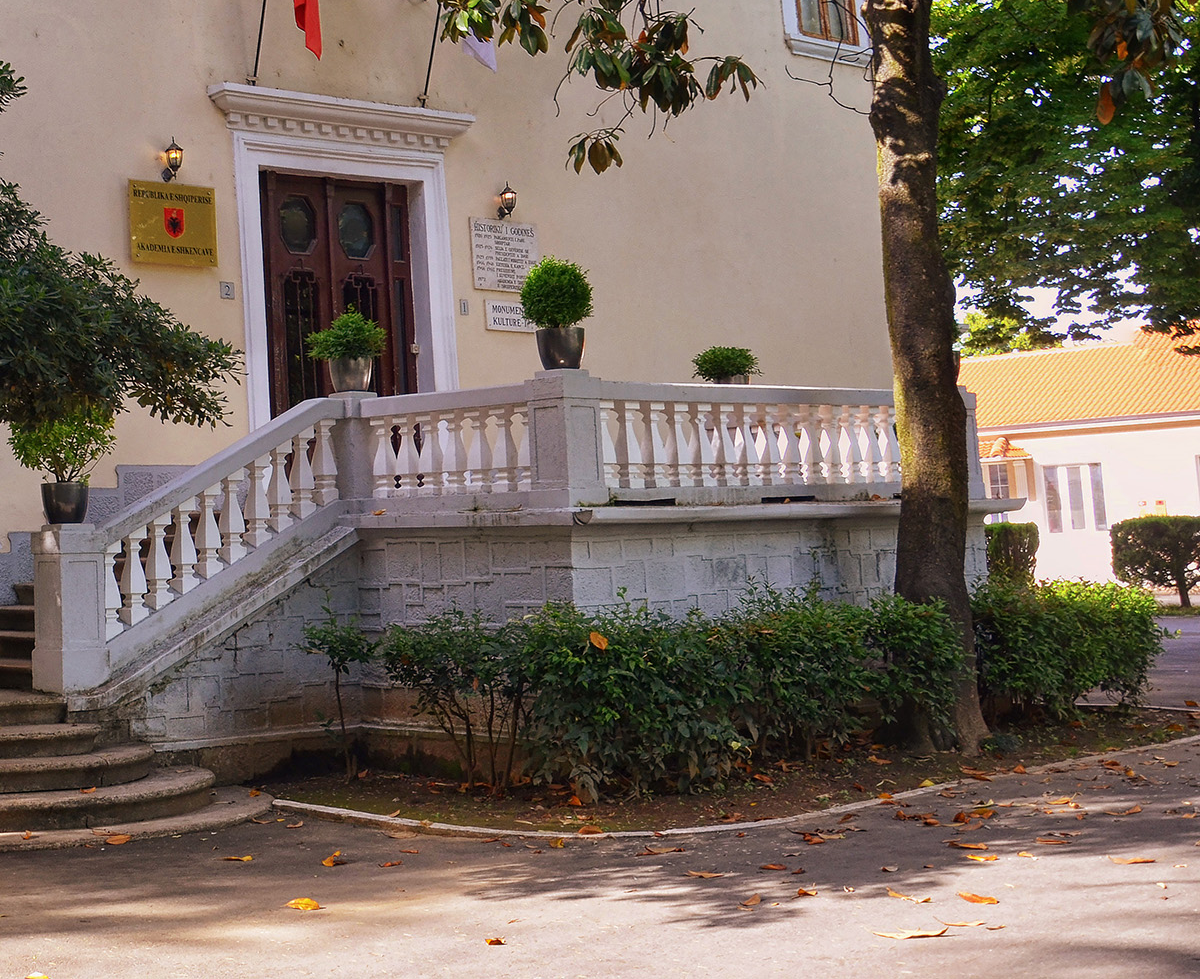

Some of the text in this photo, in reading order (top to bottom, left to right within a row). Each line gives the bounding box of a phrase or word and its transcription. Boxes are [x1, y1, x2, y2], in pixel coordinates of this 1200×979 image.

[133, 189, 169, 201] REPUBLIKA
[137, 242, 171, 253] AKADEMIA
[176, 246, 214, 256] SHKENCAVE
[224, 285, 230, 296] 2
[492, 305, 524, 315] MONUMEN
